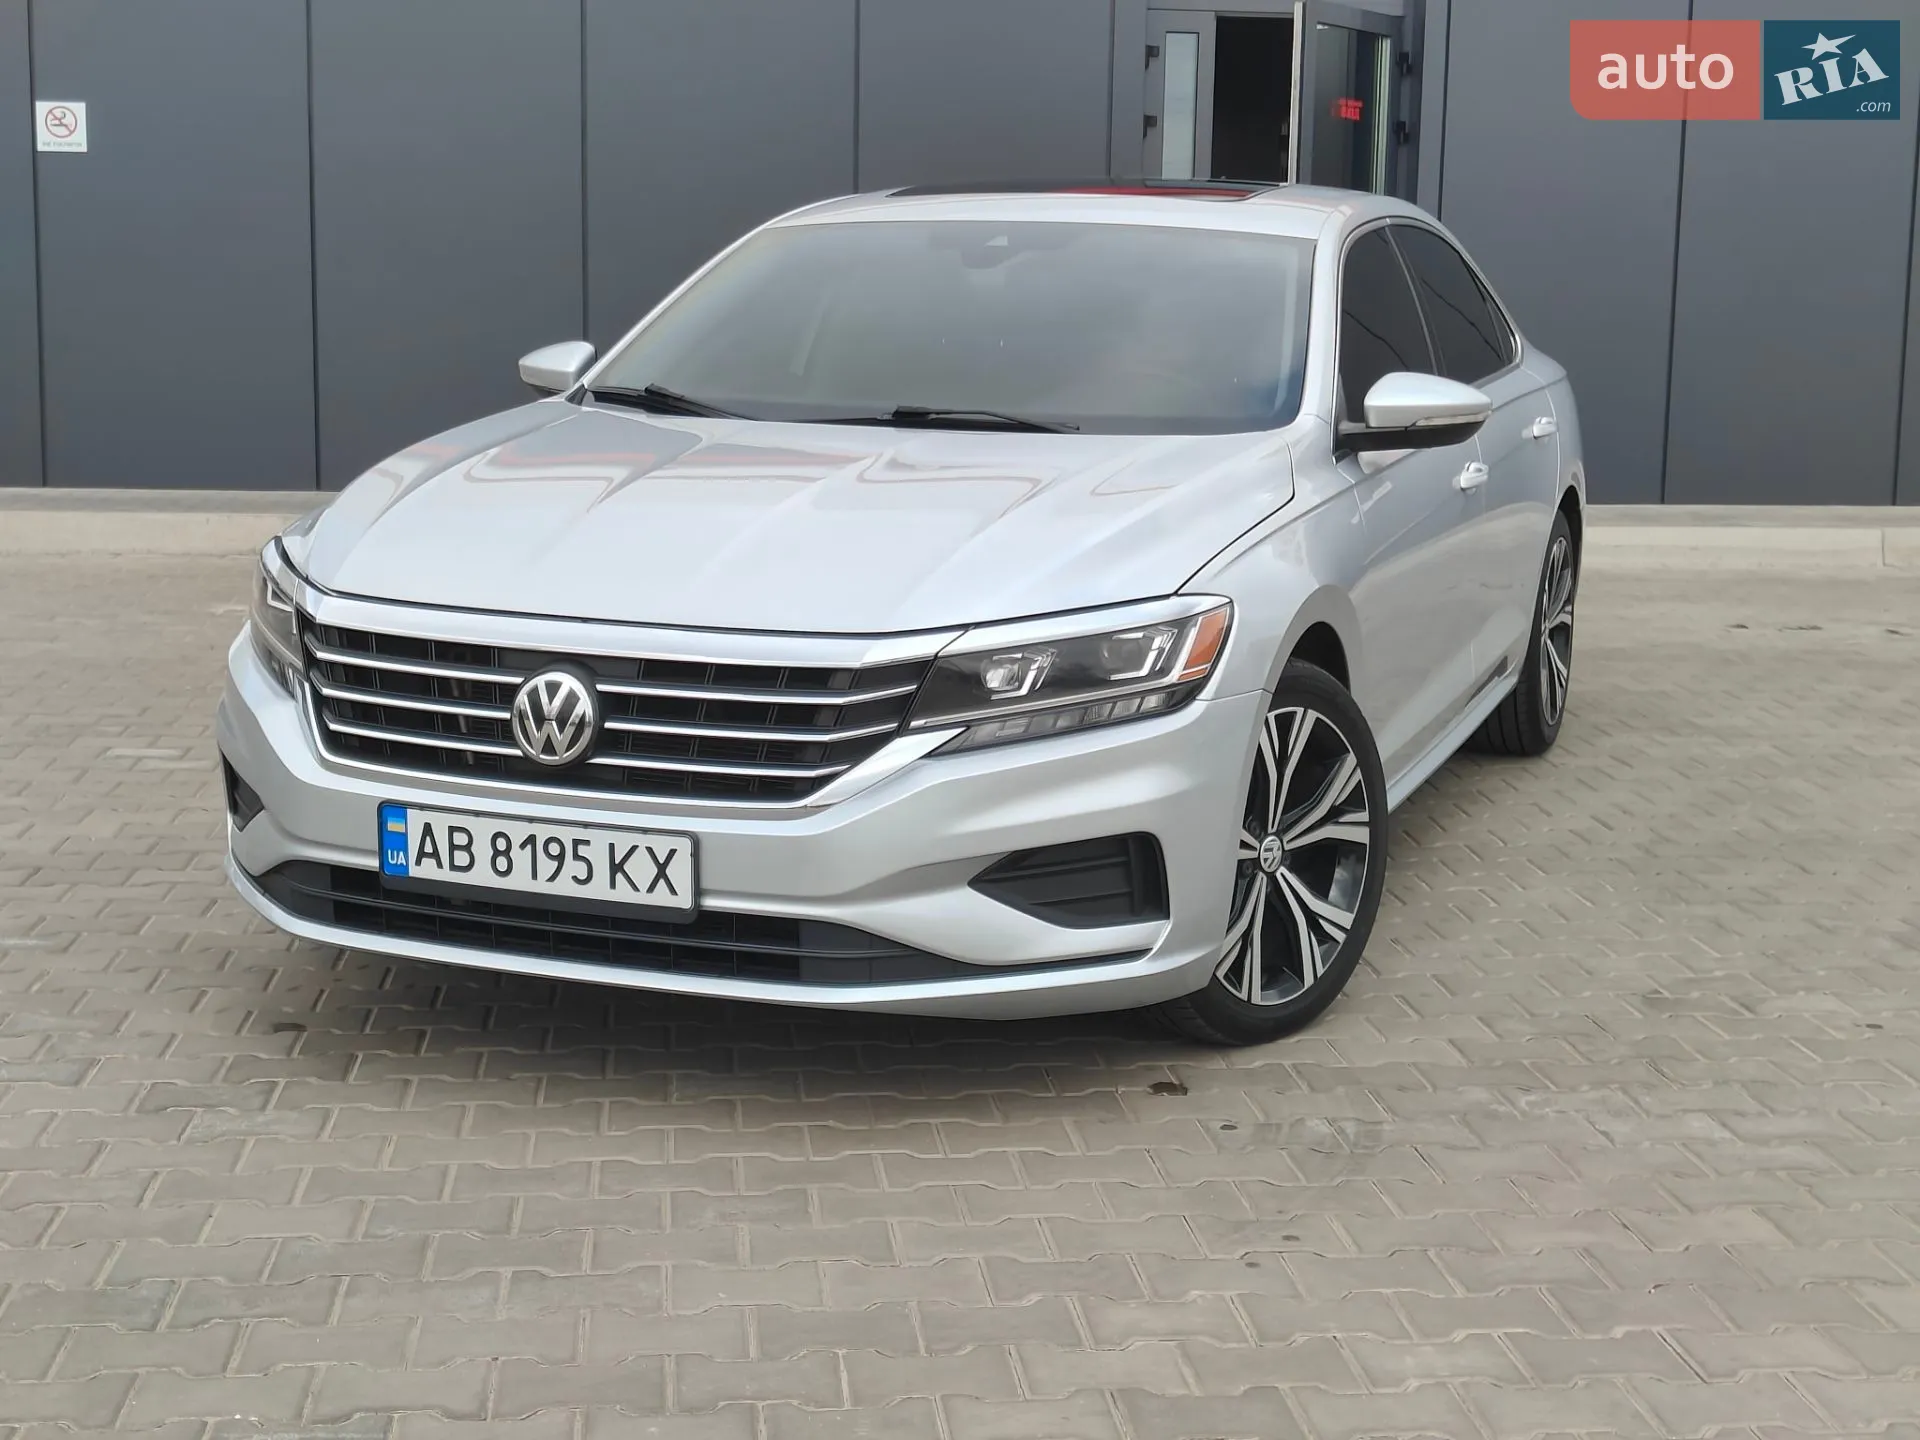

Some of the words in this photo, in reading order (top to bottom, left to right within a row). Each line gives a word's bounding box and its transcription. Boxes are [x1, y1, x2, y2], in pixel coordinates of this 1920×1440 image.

[387, 848, 407, 866] UA
[414, 821, 476, 873] AB
[489, 831, 594, 886] 8195
[608, 842, 680, 897] KX
